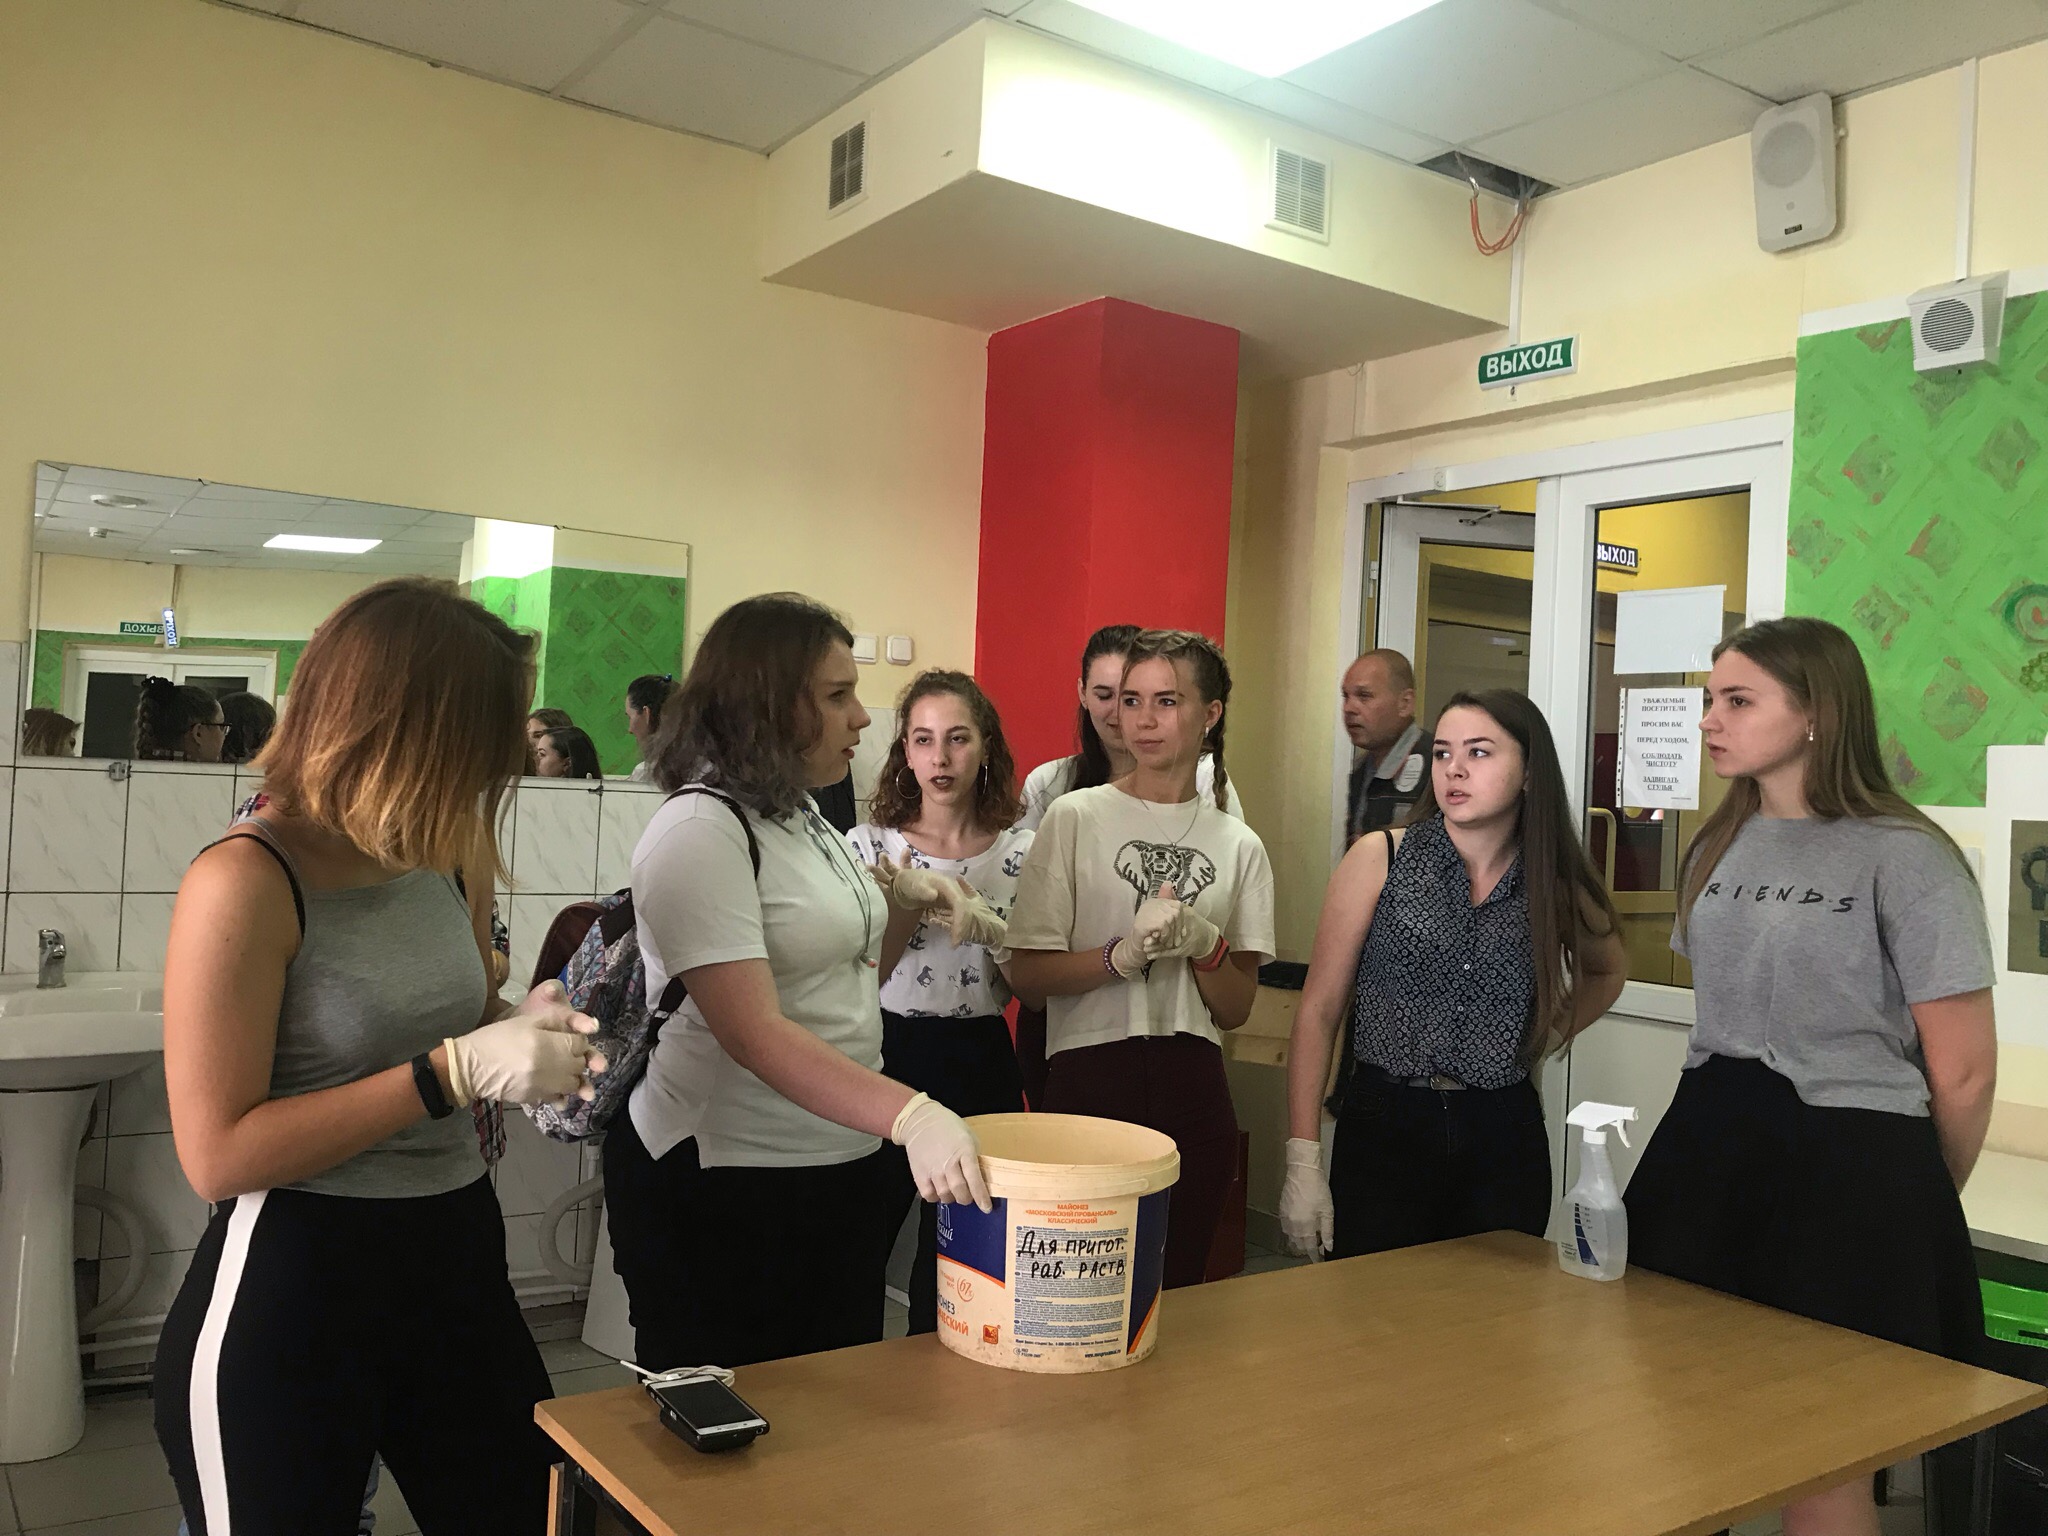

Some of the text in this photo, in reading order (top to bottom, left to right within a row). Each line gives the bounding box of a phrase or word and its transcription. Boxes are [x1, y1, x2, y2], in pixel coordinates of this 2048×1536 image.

[1486, 343, 1564, 378] ВЫХОД
[1636, 736, 1658, 744] ПЕРЕД
[1641, 752, 1683, 760] СОБЛЮДАТЬ
[1645, 760, 1678, 768] ЧИСТОТУ
[1642, 775, 1680, 783] ЗАДВИГАТЬ
[1647, 784, 1674, 792] СТУЛЬЯ
[1057, 1203, 1089, 1211] МАЙОНЕЗ
[1047, 1216, 1098, 1224] КЛАССИЧЕСКИЙ
